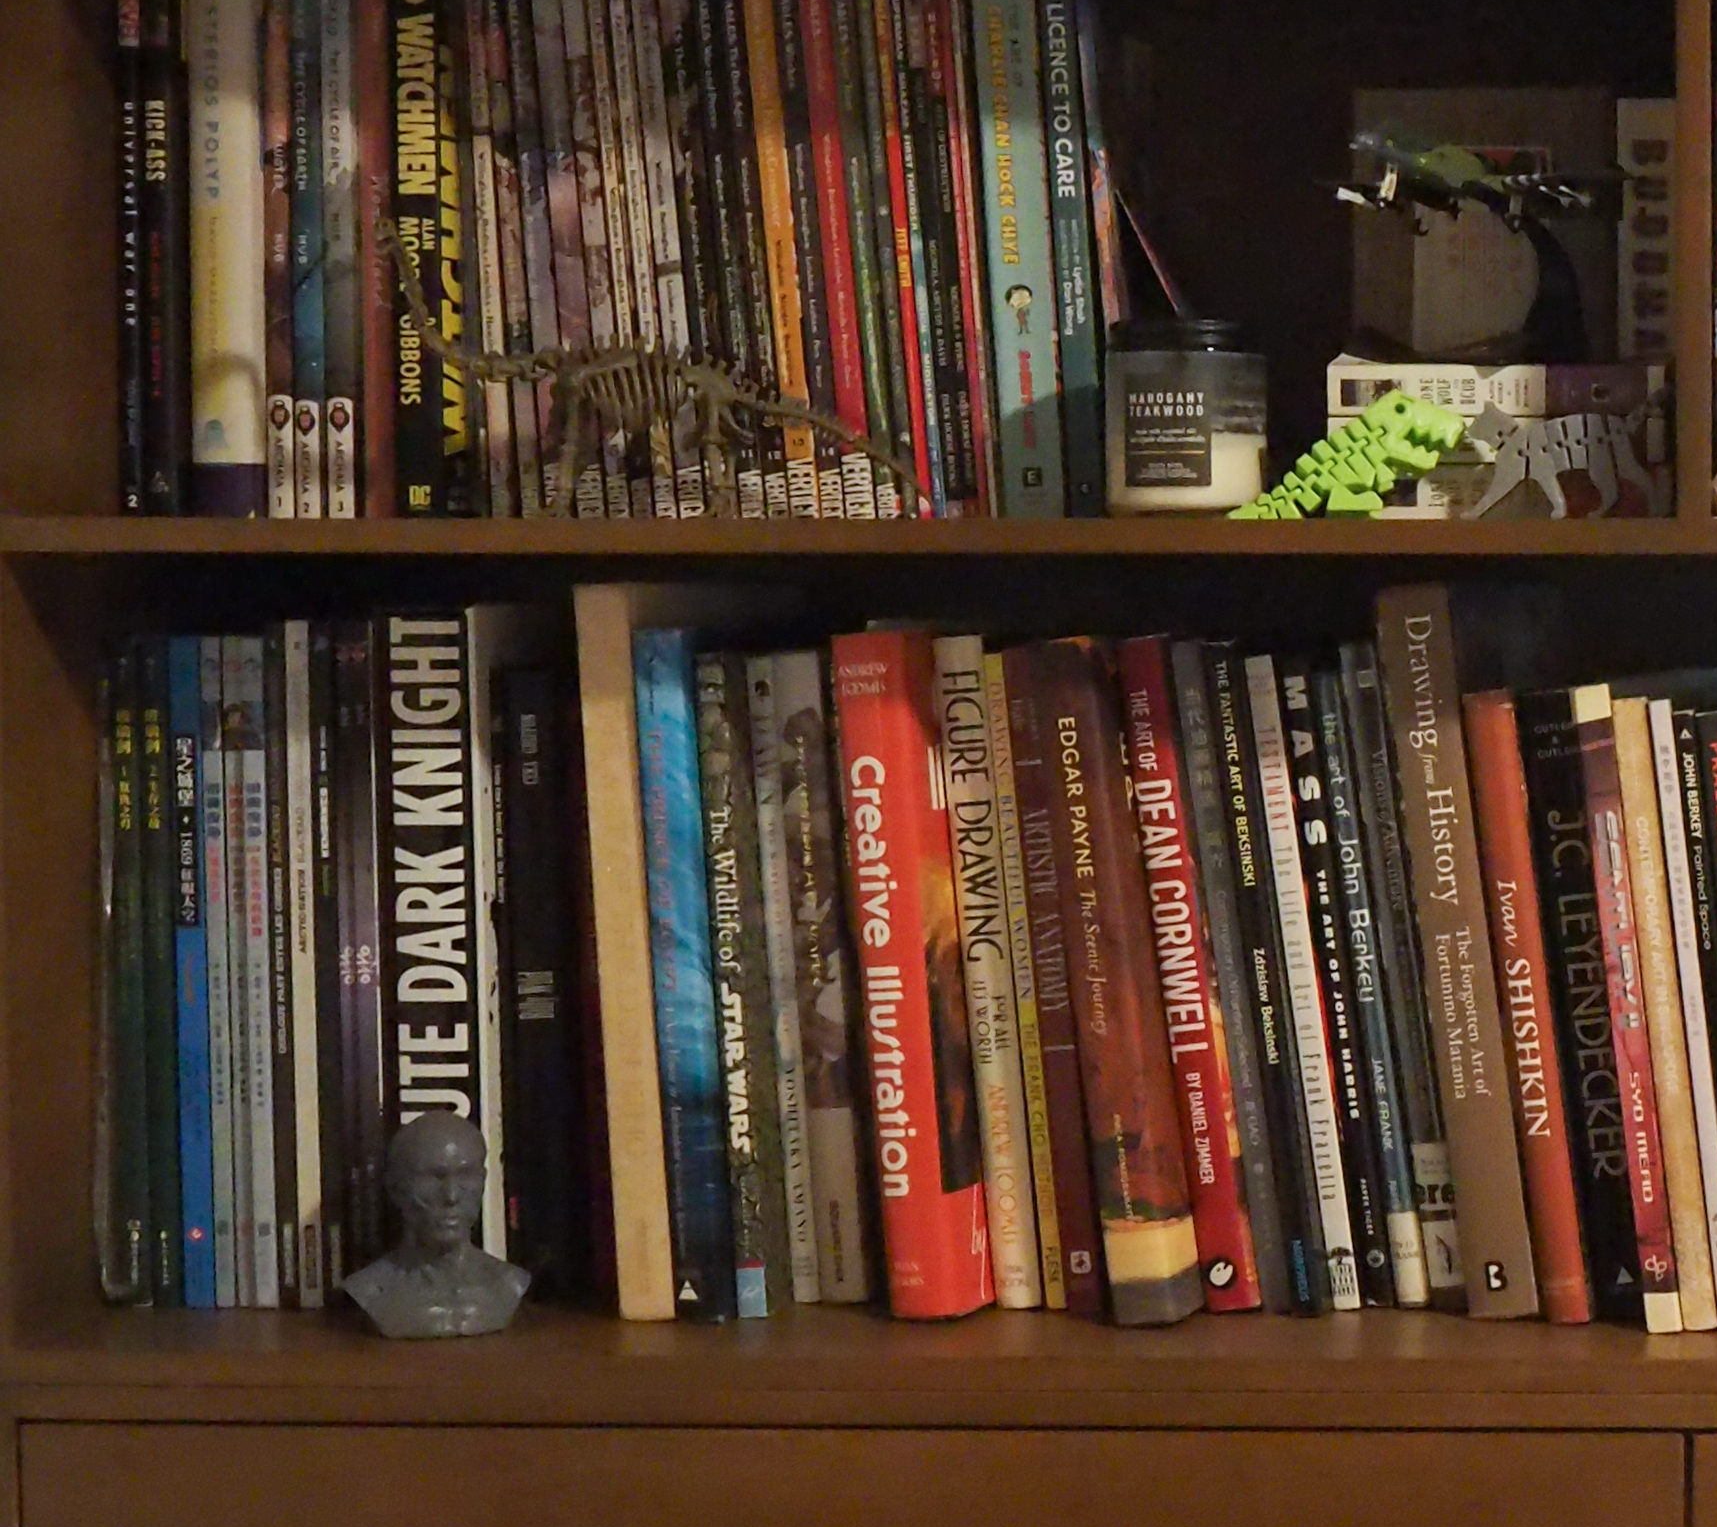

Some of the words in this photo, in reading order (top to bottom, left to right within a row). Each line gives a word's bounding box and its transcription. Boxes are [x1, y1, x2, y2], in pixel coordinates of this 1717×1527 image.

[1046, 1, 1069, 96] LICENCE
[146, 100, 165, 181] KICK-ASS
[397, 13, 435, 195] WATCHMEN
[1053, 102, 1072, 133] TO
[1055, 138, 1075, 198] CARE
[1128, 394, 1205, 405] MAHOGANY
[1128, 406, 1204, 416] TEAKWOOD
[389, 617, 467, 827] KNIGHT
[1129, 689, 1150, 717] THE
[1404, 615, 1440, 748] Drawing
[940, 672, 987, 785] FIGURE
[1058, 717, 1085, 798] EDGAR
[1134, 722, 1155, 749] ART
[1139, 752, 1157, 771] OF
[1283, 676, 1328, 845] MASS
[1418, 752, 1436, 783] from
[1683, 752, 1699, 791] JOHN
[710, 807, 729, 844] The
[857, 756, 896, 947] Creative
[1066, 804, 1094, 879] PAYNE
[1132, 780, 1186, 871] DEAN
[1426, 787, 1458, 905] History
[1546, 810, 1578, 878] J.C.
[1686, 794, 1703, 838] BERKEY
[713, 850, 737, 938] Wildlife
[955, 800, 1002, 962] DRAWING
[1496, 880, 1518, 946] Ivan
[395, 846, 469, 1003] DARK
[720, 946, 740, 969] of
[1148, 880, 1209, 1064] CORNWELL
[722, 983, 744, 1067] STAR
[1505, 957, 1549, 1136] SHISHKIN
[1556, 894, 1625, 1178] LEYENDECKER
[727, 1071, 750, 1154] WARS
[867, 966, 911, 1197] Illustration
